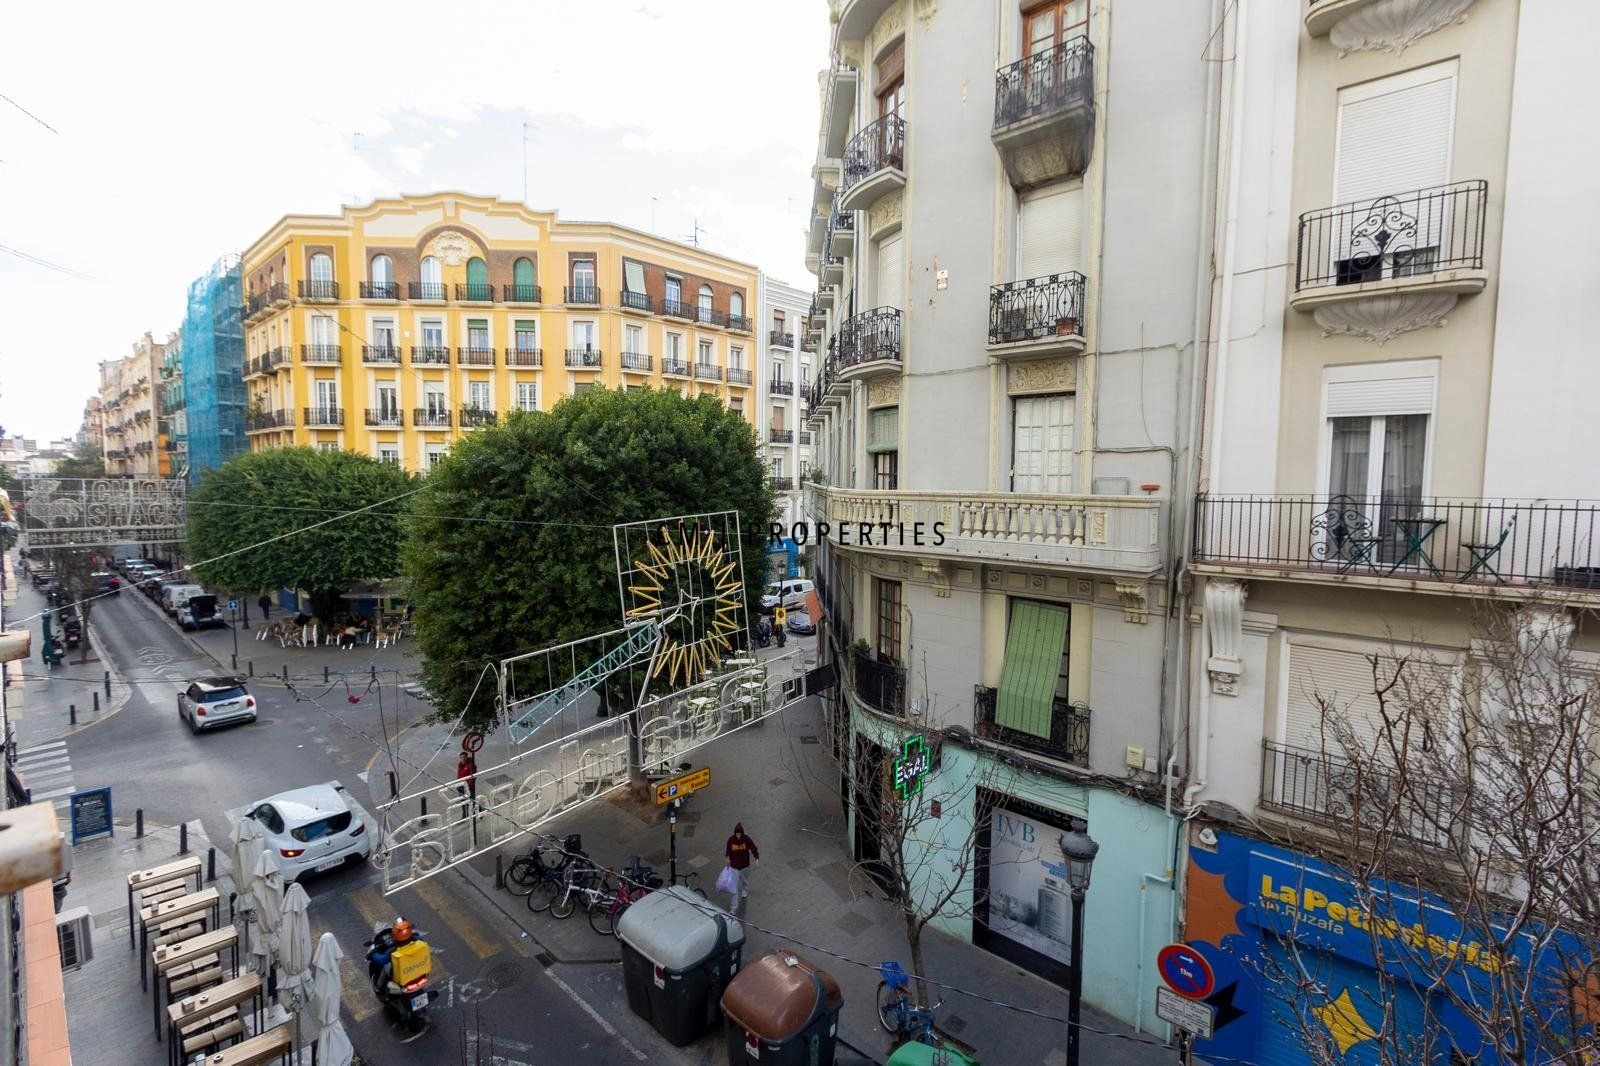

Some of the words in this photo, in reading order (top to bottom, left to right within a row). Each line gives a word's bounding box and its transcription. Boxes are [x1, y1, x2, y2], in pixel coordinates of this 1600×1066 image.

[91, 480, 186, 504] CHICK
[87, 503, 187, 527] SHACK
[670, 785, 677, 796] P
[1262, 874, 1297, 905] La
[1285, 904, 1344, 935] Ruzafa
